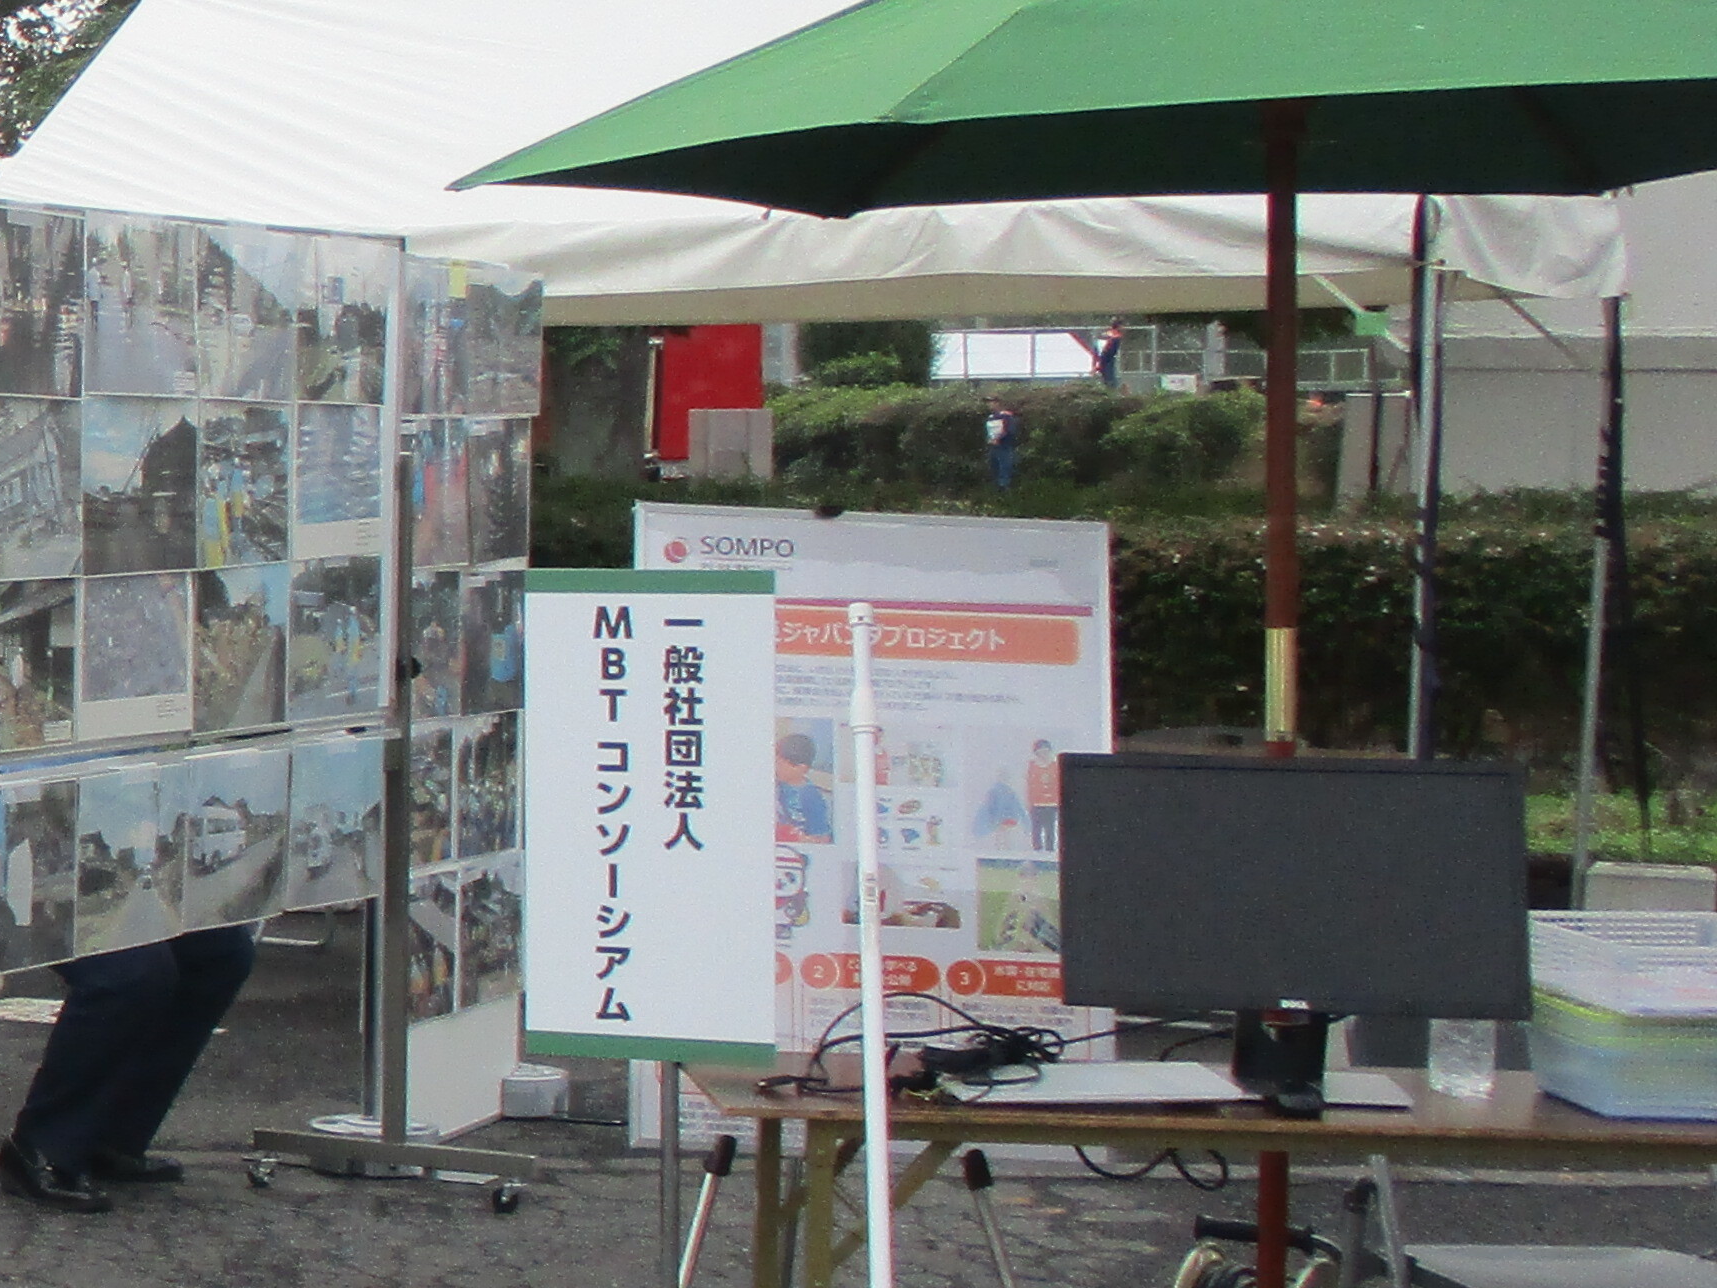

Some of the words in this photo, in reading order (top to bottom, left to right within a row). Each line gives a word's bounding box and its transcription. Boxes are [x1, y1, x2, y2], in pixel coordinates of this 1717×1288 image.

[699, 534, 795, 559] SOMPO
[663, 616, 704, 851] 一般社団法人
[813, 965, 824, 979] 2
[959, 971, 970, 986] 3
